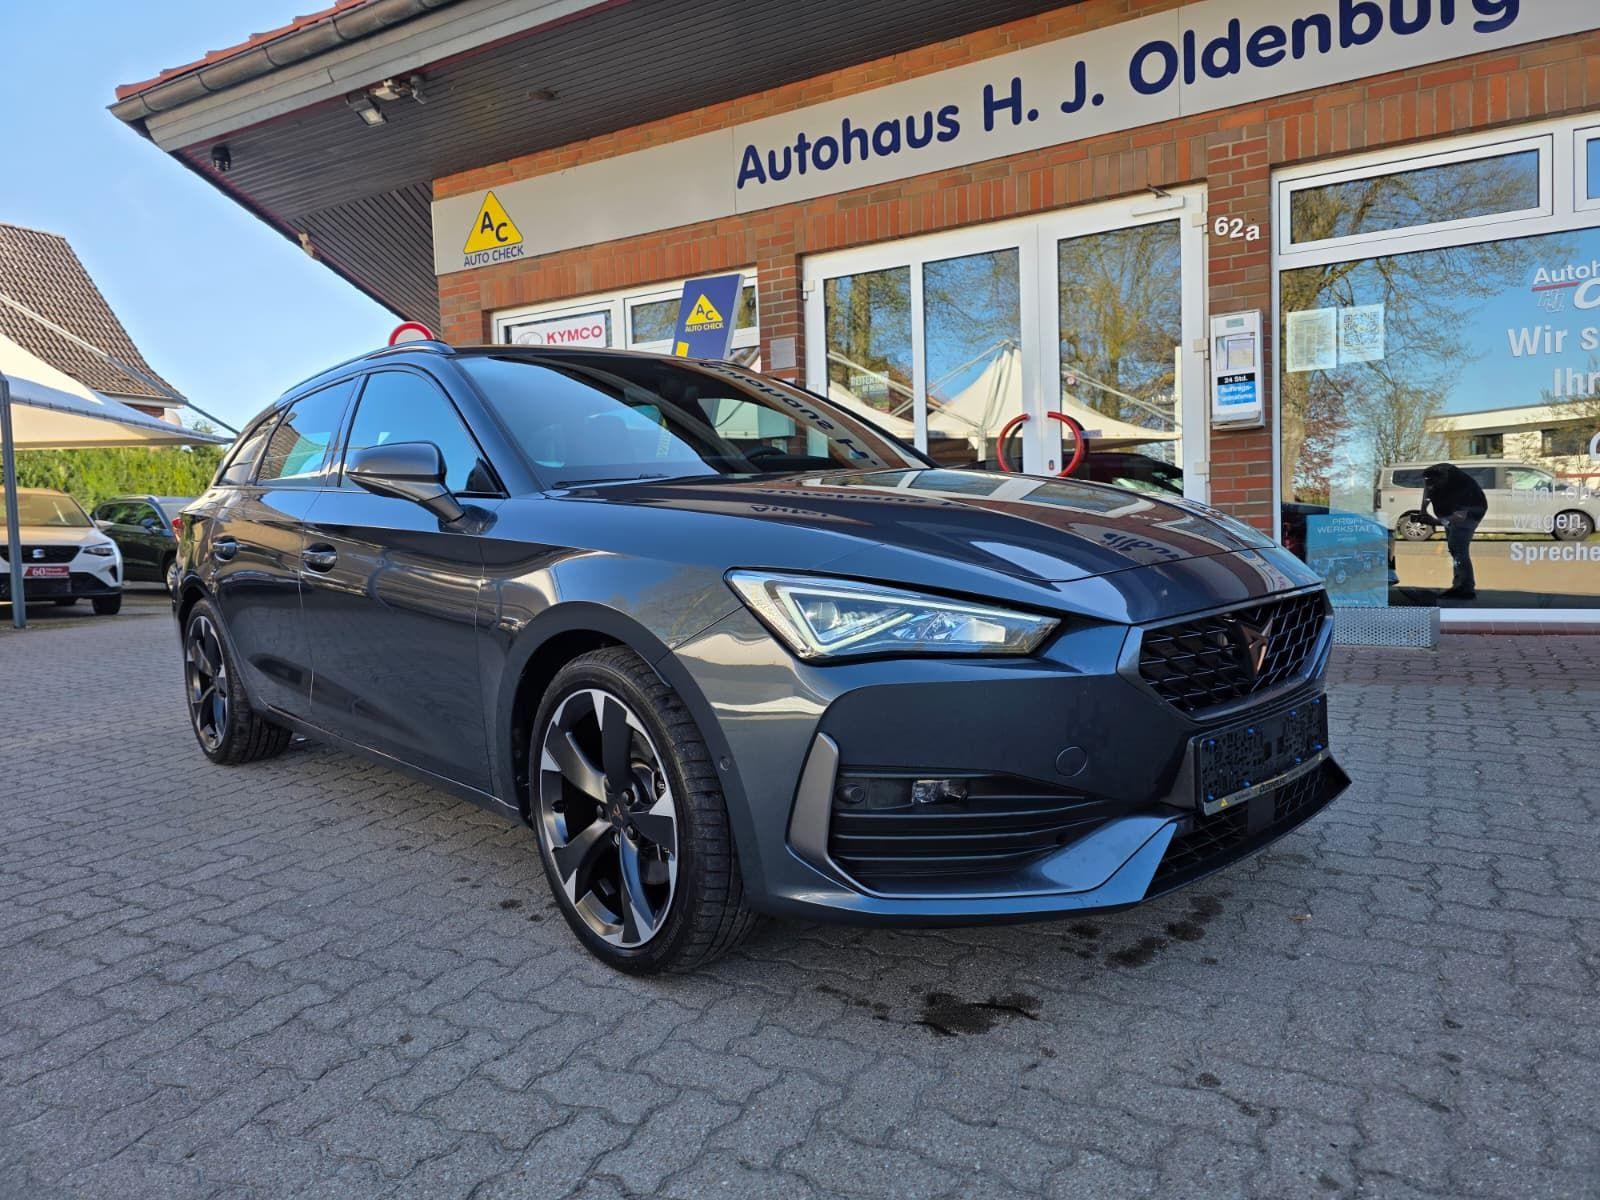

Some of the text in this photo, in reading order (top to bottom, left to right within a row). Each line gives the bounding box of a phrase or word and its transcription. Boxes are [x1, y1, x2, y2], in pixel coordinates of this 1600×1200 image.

[736, 104, 960, 189] Autohaus
[983, 76, 1039, 132] H.
[1060, 60, 1104, 113] J.
[1214, 216, 1260, 241] 62a
[463, 244, 524, 268] AUTO CHECK
[546, 325, 603, 344] KYMCO
[685, 321, 724, 333] AUTO CHECK
[1507, 325, 1568, 357] Wir
[1510, 542, 1600, 565] Spreche
[32, 567, 46, 576] 60
